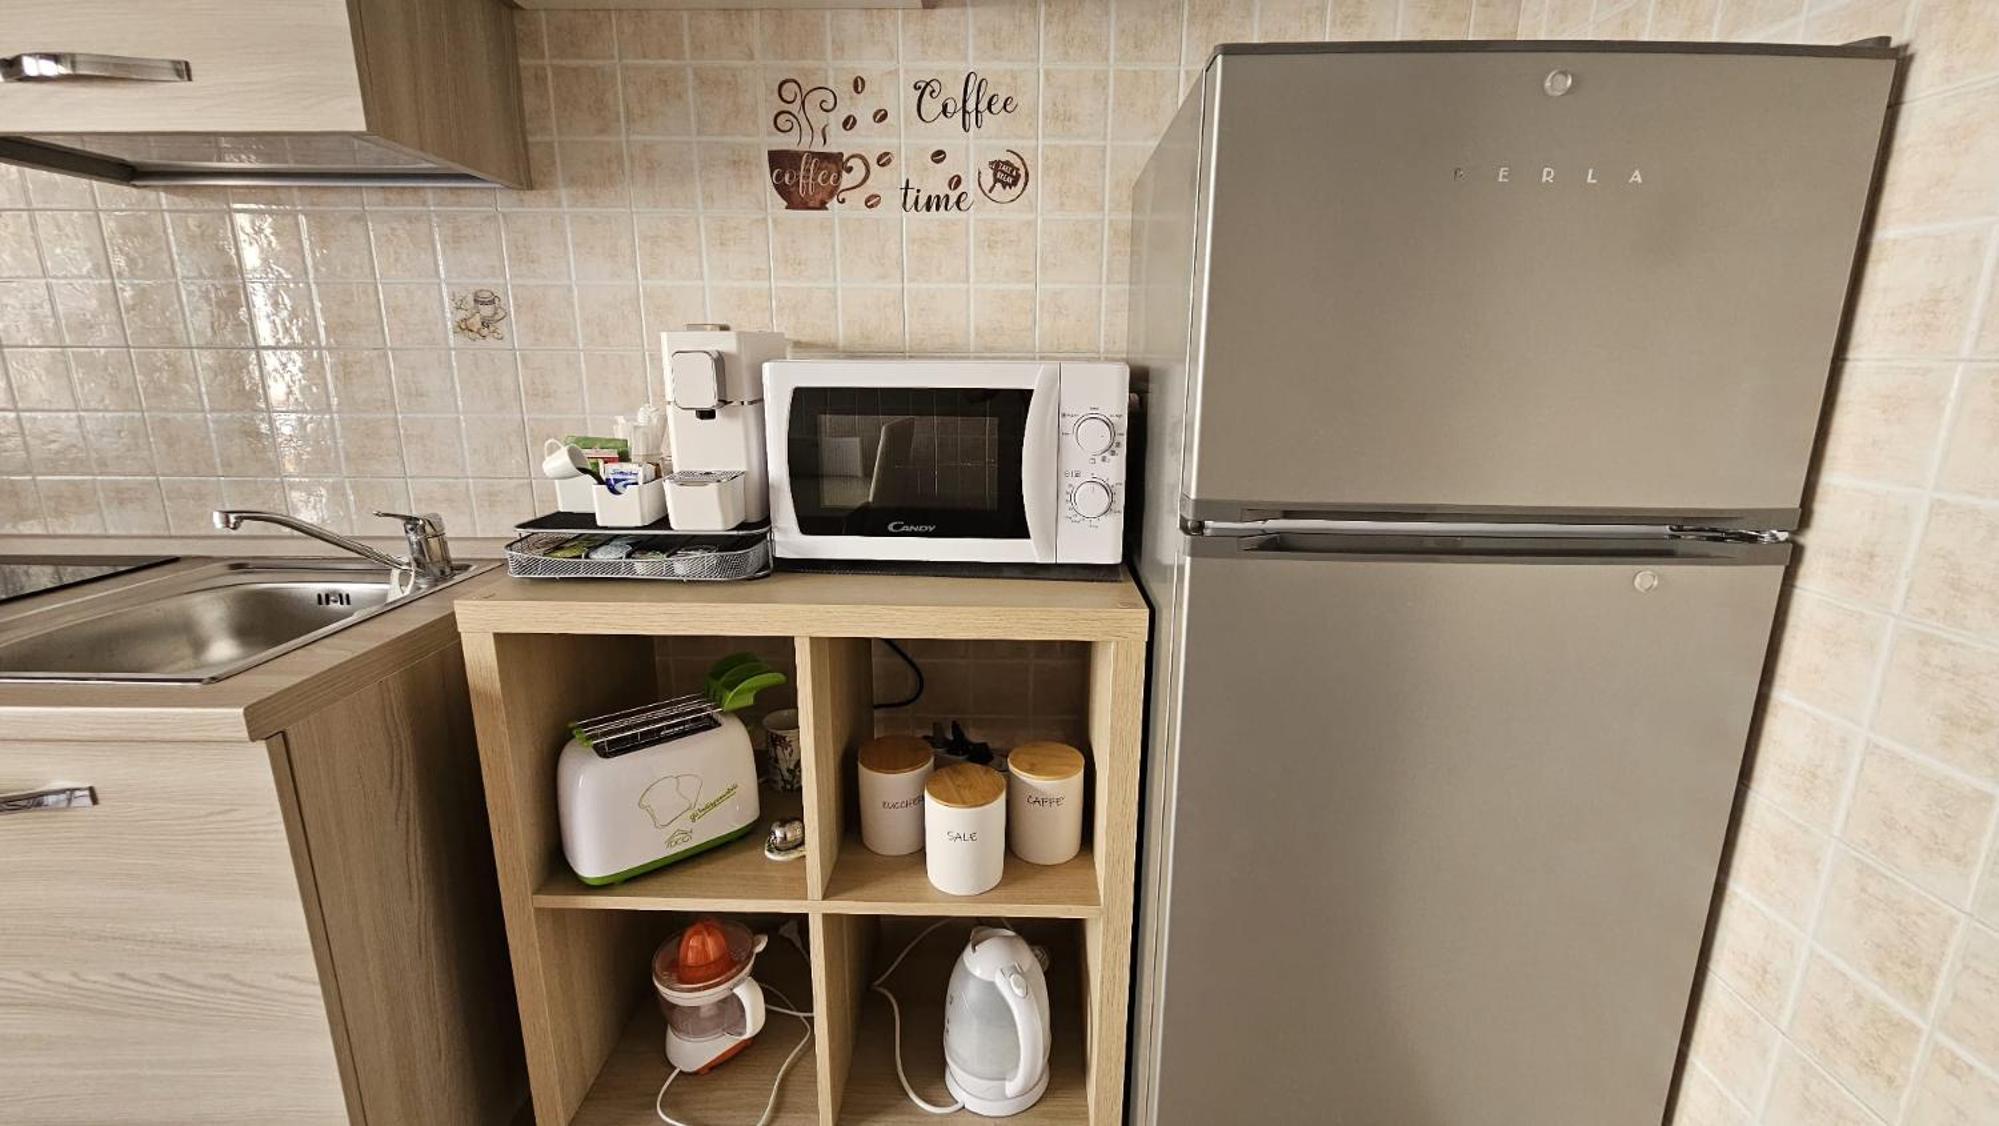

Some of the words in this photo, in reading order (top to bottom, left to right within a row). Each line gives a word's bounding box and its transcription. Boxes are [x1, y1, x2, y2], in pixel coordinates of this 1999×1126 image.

[913, 71, 1018, 132] Coffee
[772, 152, 841, 197] coffee
[900, 178, 974, 213] time
[946, 830, 978, 843] SALE
